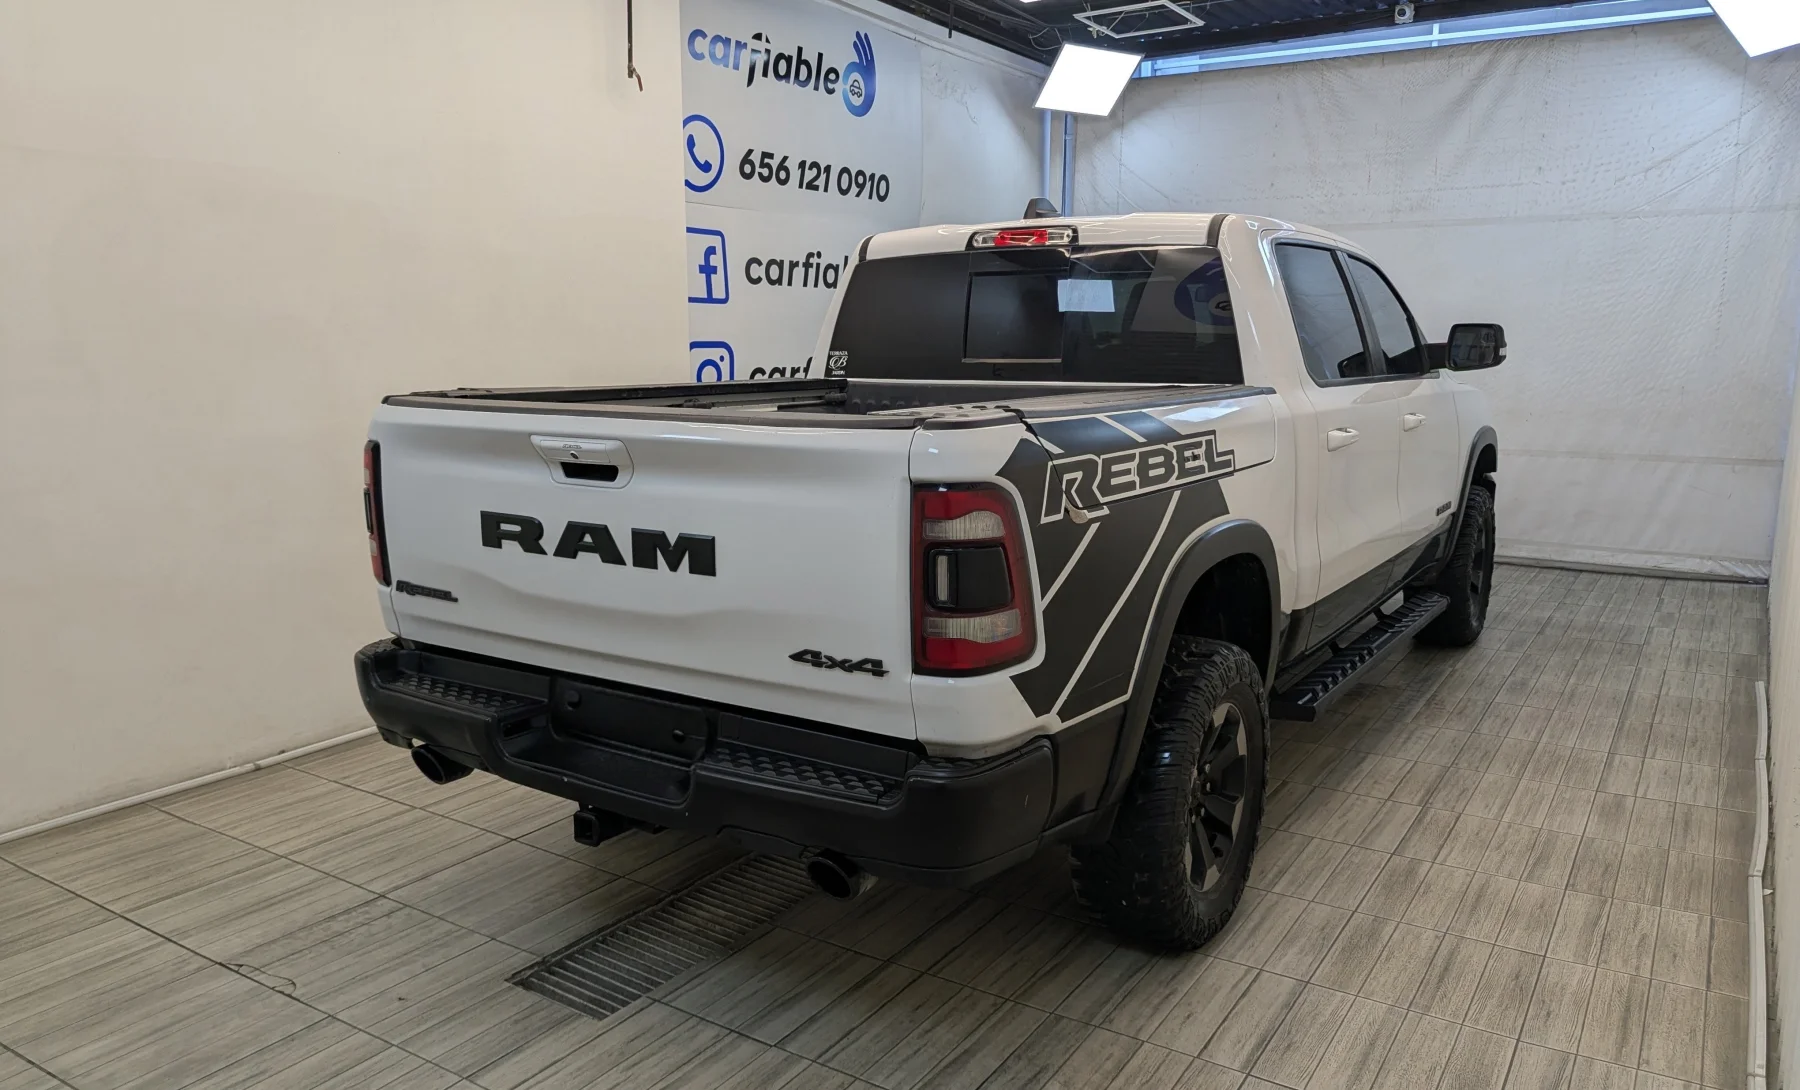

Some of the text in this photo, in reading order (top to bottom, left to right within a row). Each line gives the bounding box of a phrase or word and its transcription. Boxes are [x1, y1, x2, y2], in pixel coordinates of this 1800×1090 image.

[687, 28, 840, 95] carfiable
[738, 148, 890, 203] 656 121 0910
[1040, 433, 1235, 525] REBEL
[480, 510, 717, 577] RAM
